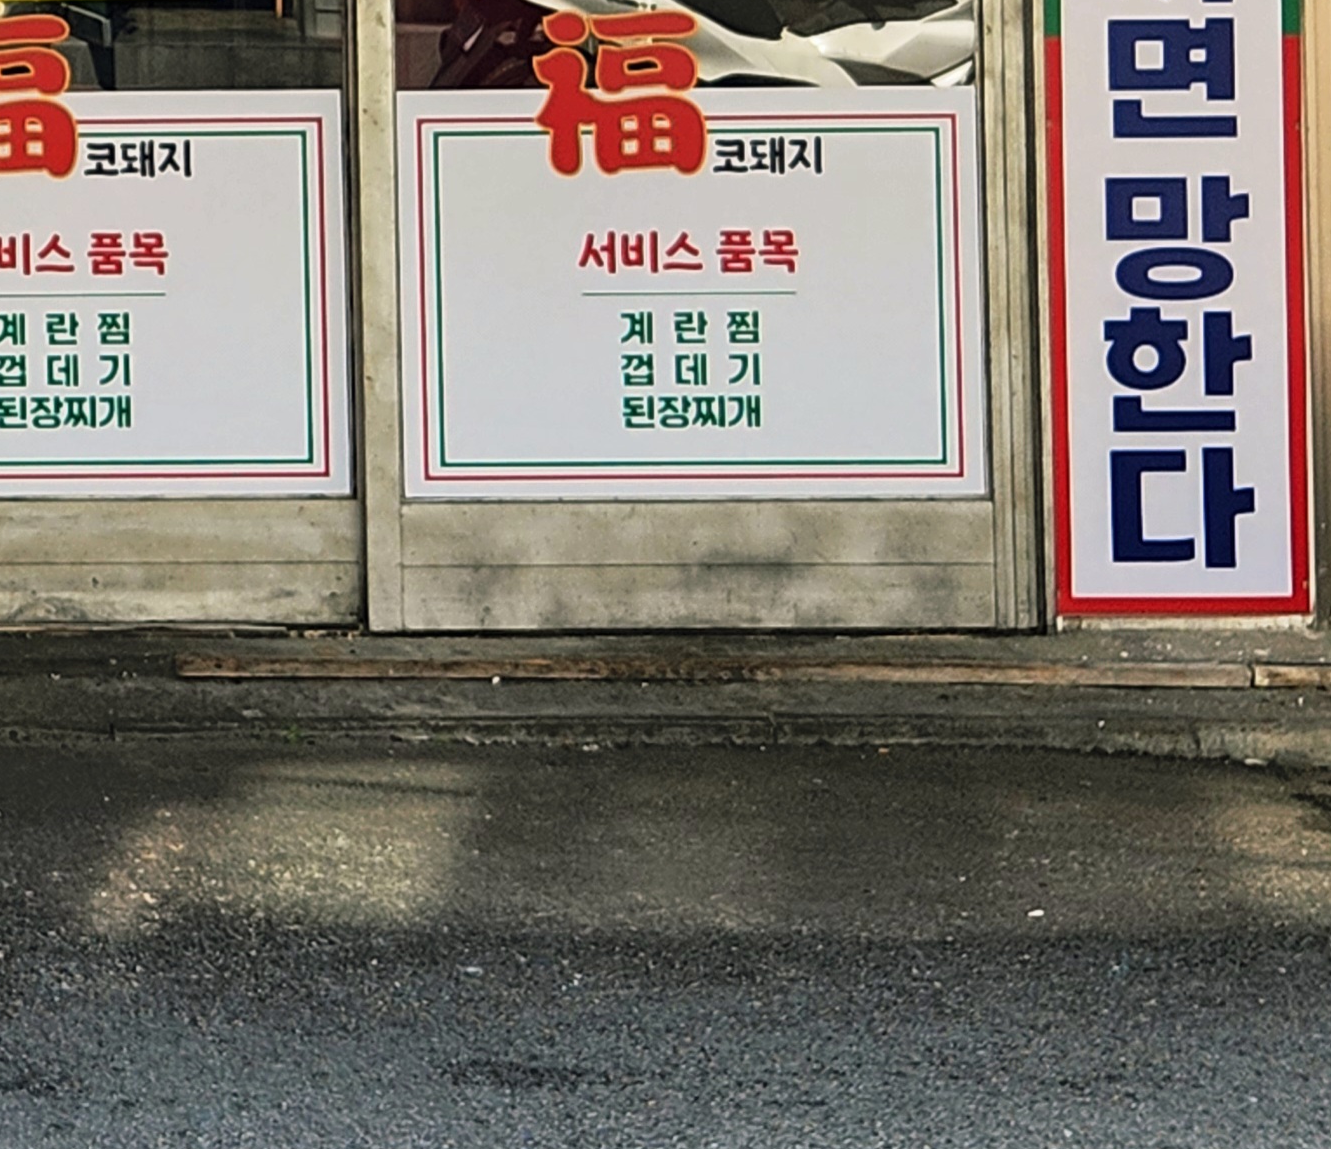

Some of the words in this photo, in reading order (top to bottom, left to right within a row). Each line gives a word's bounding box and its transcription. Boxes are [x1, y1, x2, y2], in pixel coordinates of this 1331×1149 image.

[533, 9, 708, 177] 福
[712, 136, 824, 175] 코돼지
[83, 140, 192, 178] 코돼지
[87, 232, 169, 276] 품목
[577, 230, 704, 274] 서비스
[715, 230, 800, 274] 품목
[1103, 175, 1256, 569] 망한다
[620, 394, 762, 430] 된장찌개
